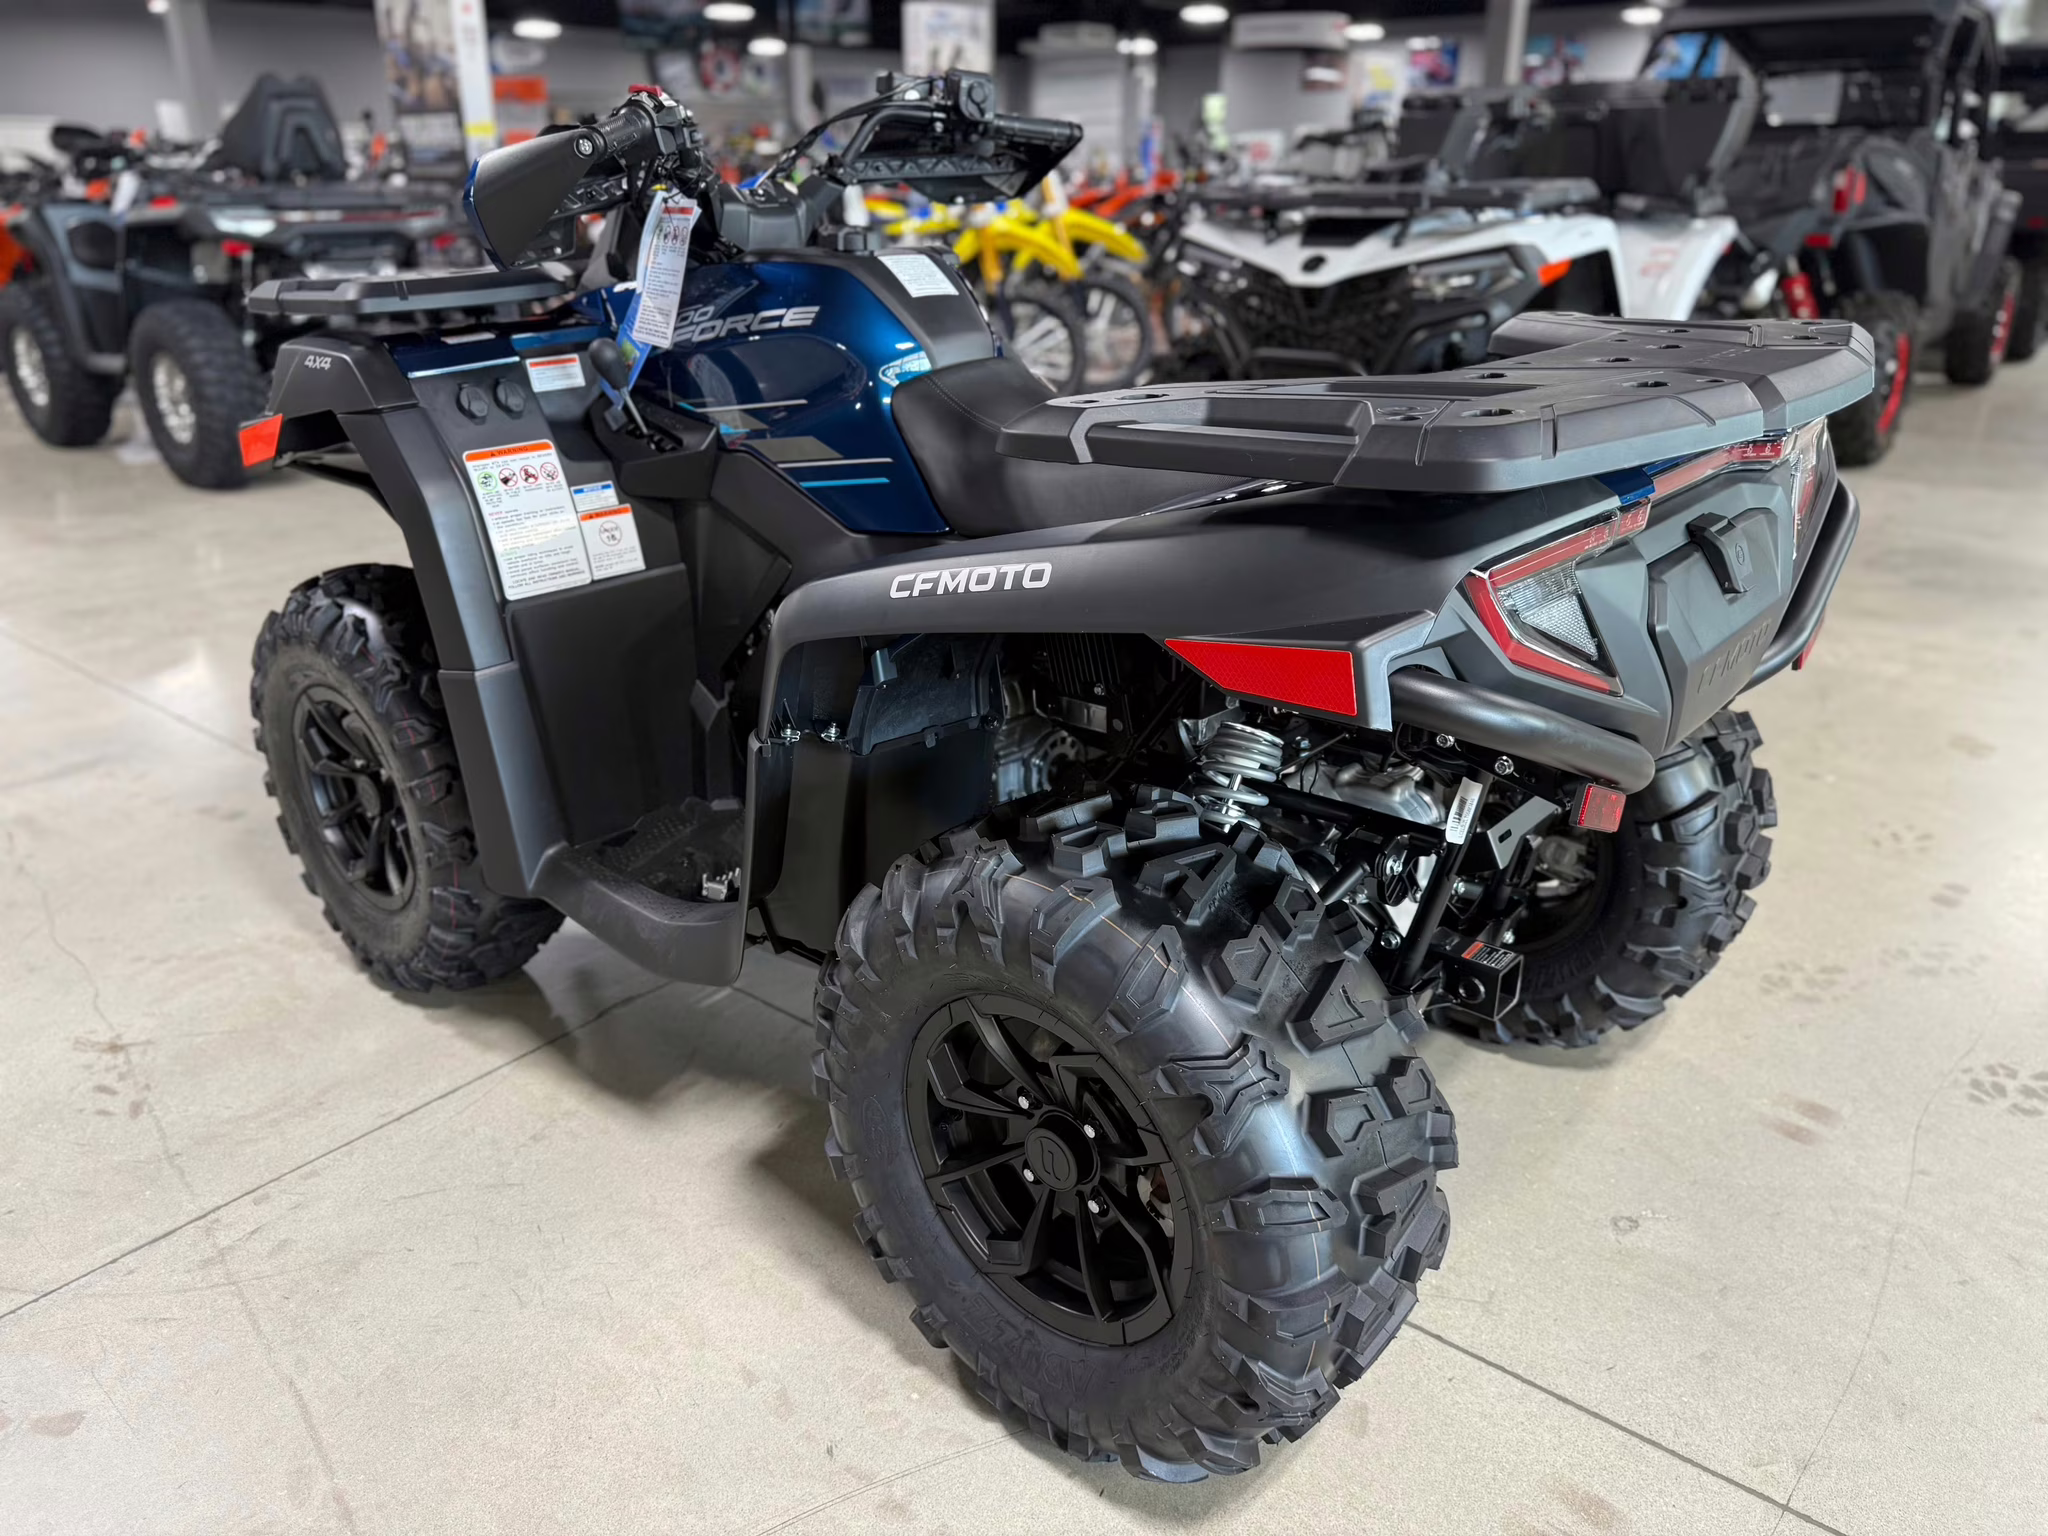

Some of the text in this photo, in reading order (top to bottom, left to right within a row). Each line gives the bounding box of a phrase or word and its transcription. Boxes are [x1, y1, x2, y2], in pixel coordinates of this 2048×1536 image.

[304, 354, 332, 371] 4X4
[498, 446, 528, 455] WARNING
[889, 562, 1053, 600] CFMOTO
